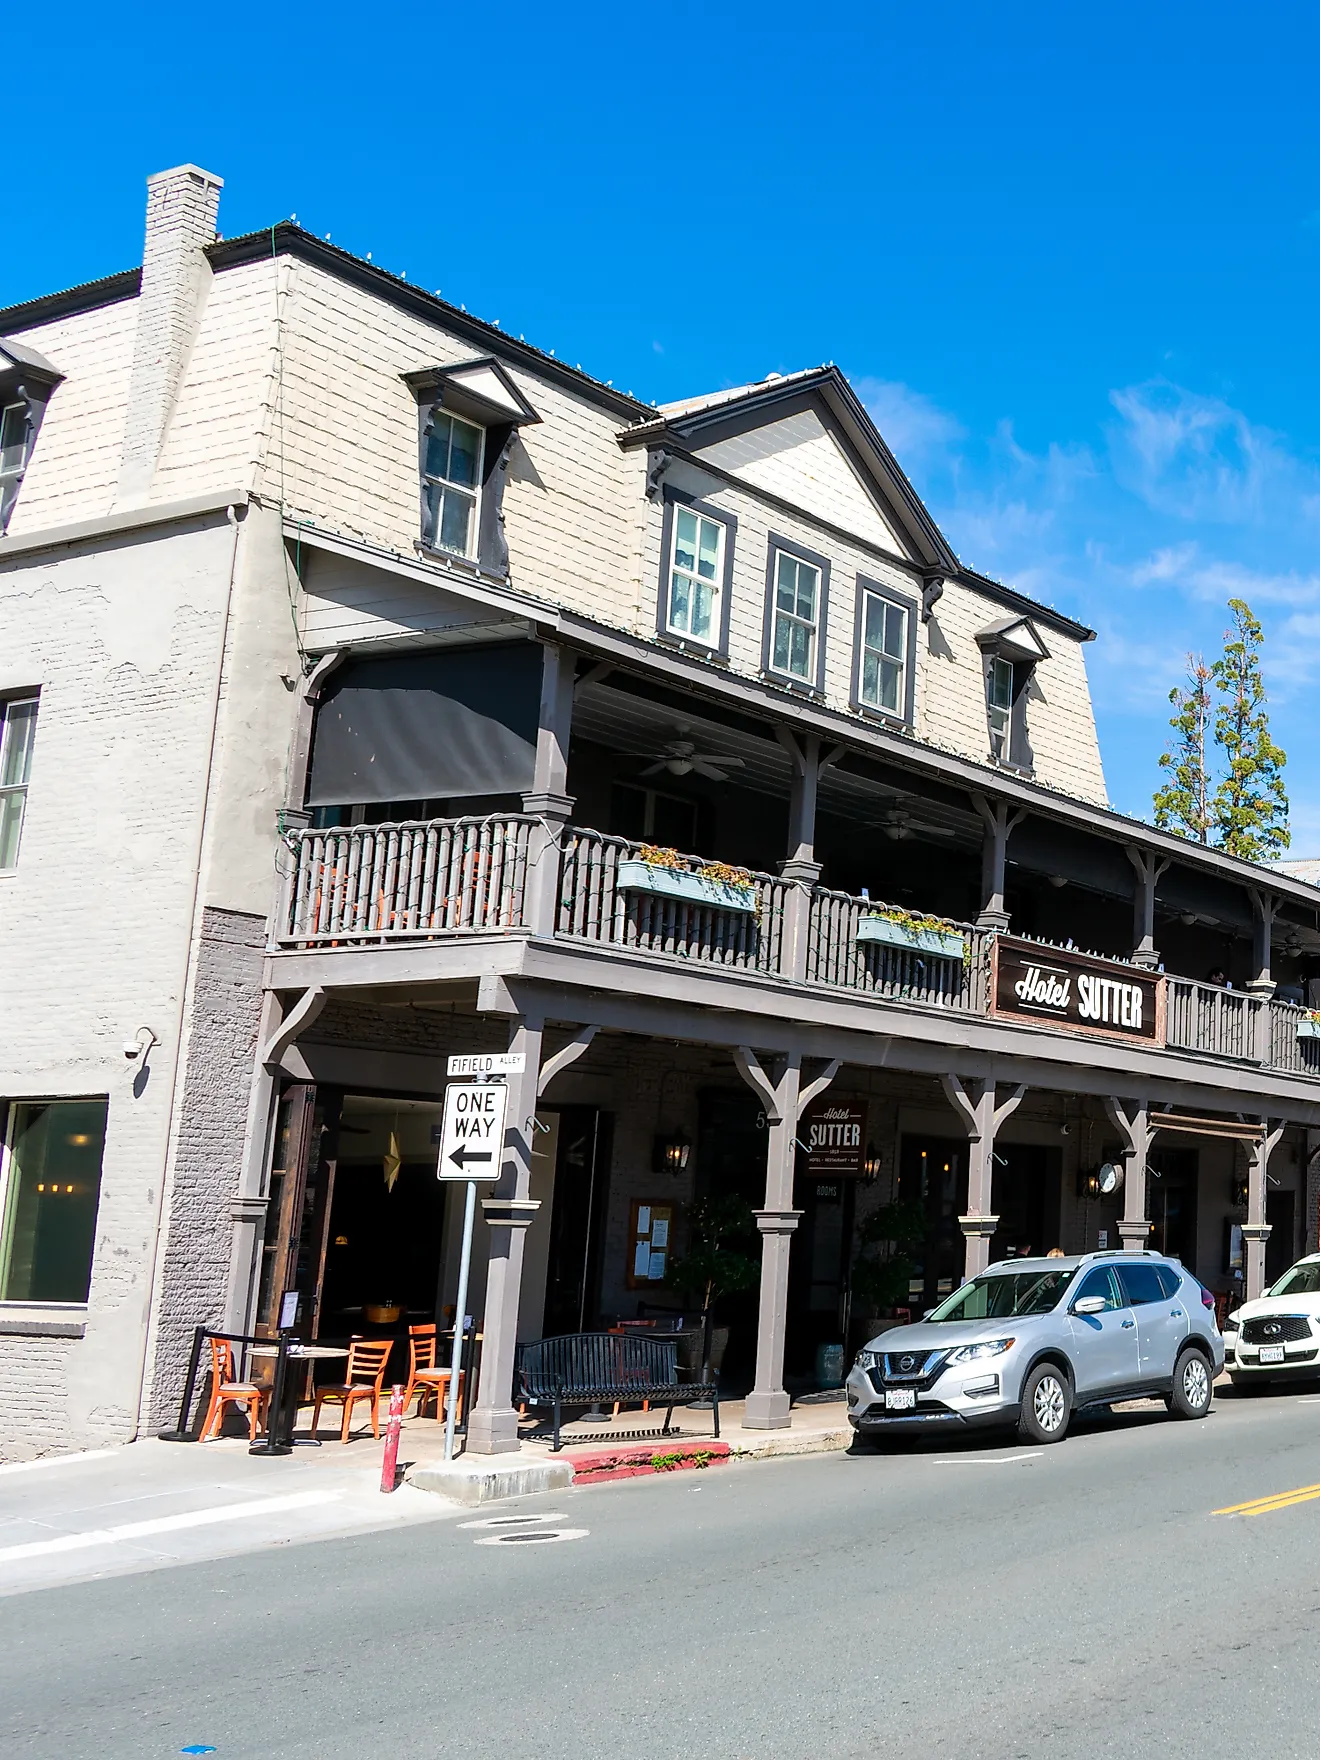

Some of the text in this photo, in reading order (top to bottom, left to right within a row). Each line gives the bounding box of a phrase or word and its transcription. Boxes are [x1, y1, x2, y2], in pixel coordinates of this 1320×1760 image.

[1014, 966, 1143, 1029] Hotel SUTTER
[451, 1056, 522, 1073] FIFIELD ALLEY
[456, 1092, 496, 1113] ONE
[823, 1107, 850, 1120] Hotel
[455, 1117, 496, 1138] WAY
[809, 1123, 861, 1147] SUTTER
[816, 1185, 837, 1197] ROOMS
